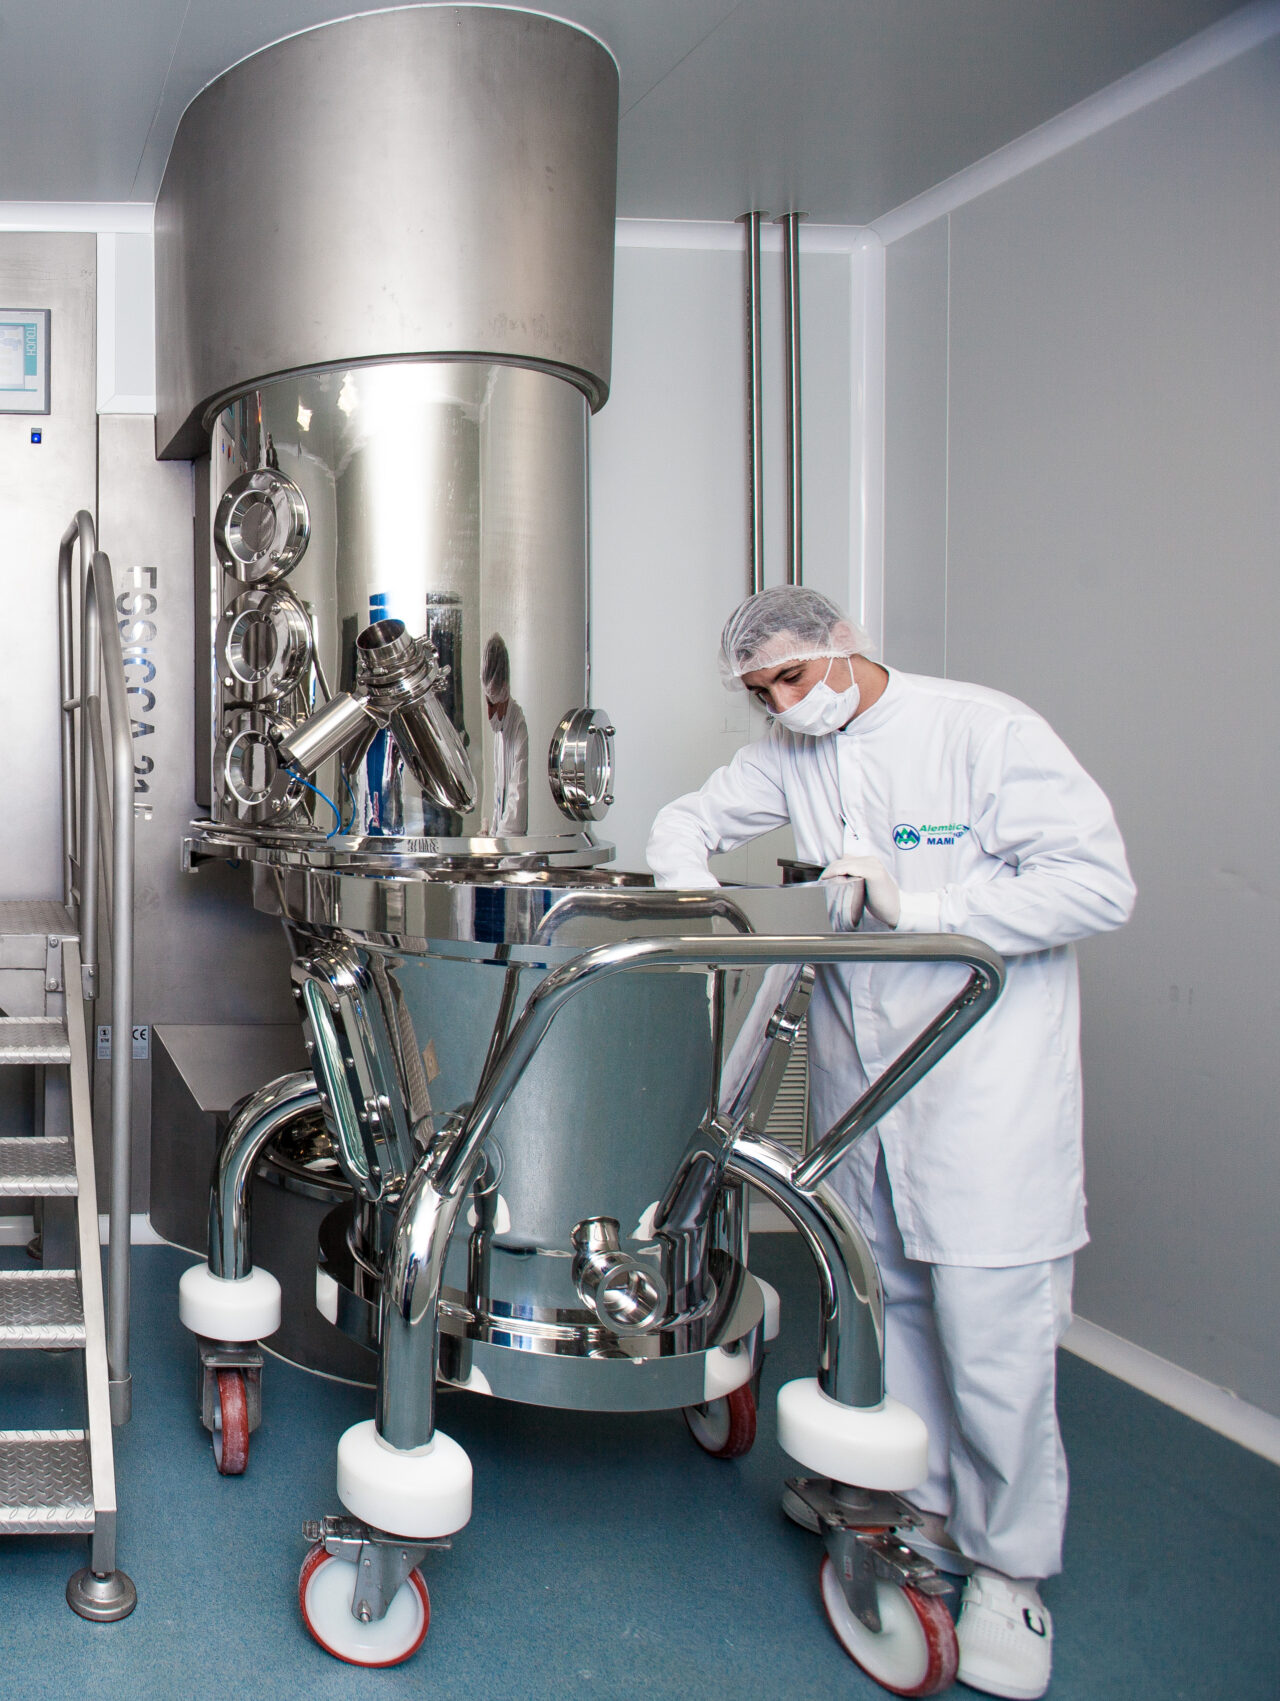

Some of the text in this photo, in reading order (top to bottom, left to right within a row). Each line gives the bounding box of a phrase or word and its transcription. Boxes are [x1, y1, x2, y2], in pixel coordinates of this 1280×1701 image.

[25, 324, 37, 356] TOUCH
[927, 837, 954, 845] MAMI
[132, 1029, 147, 1041] CE
